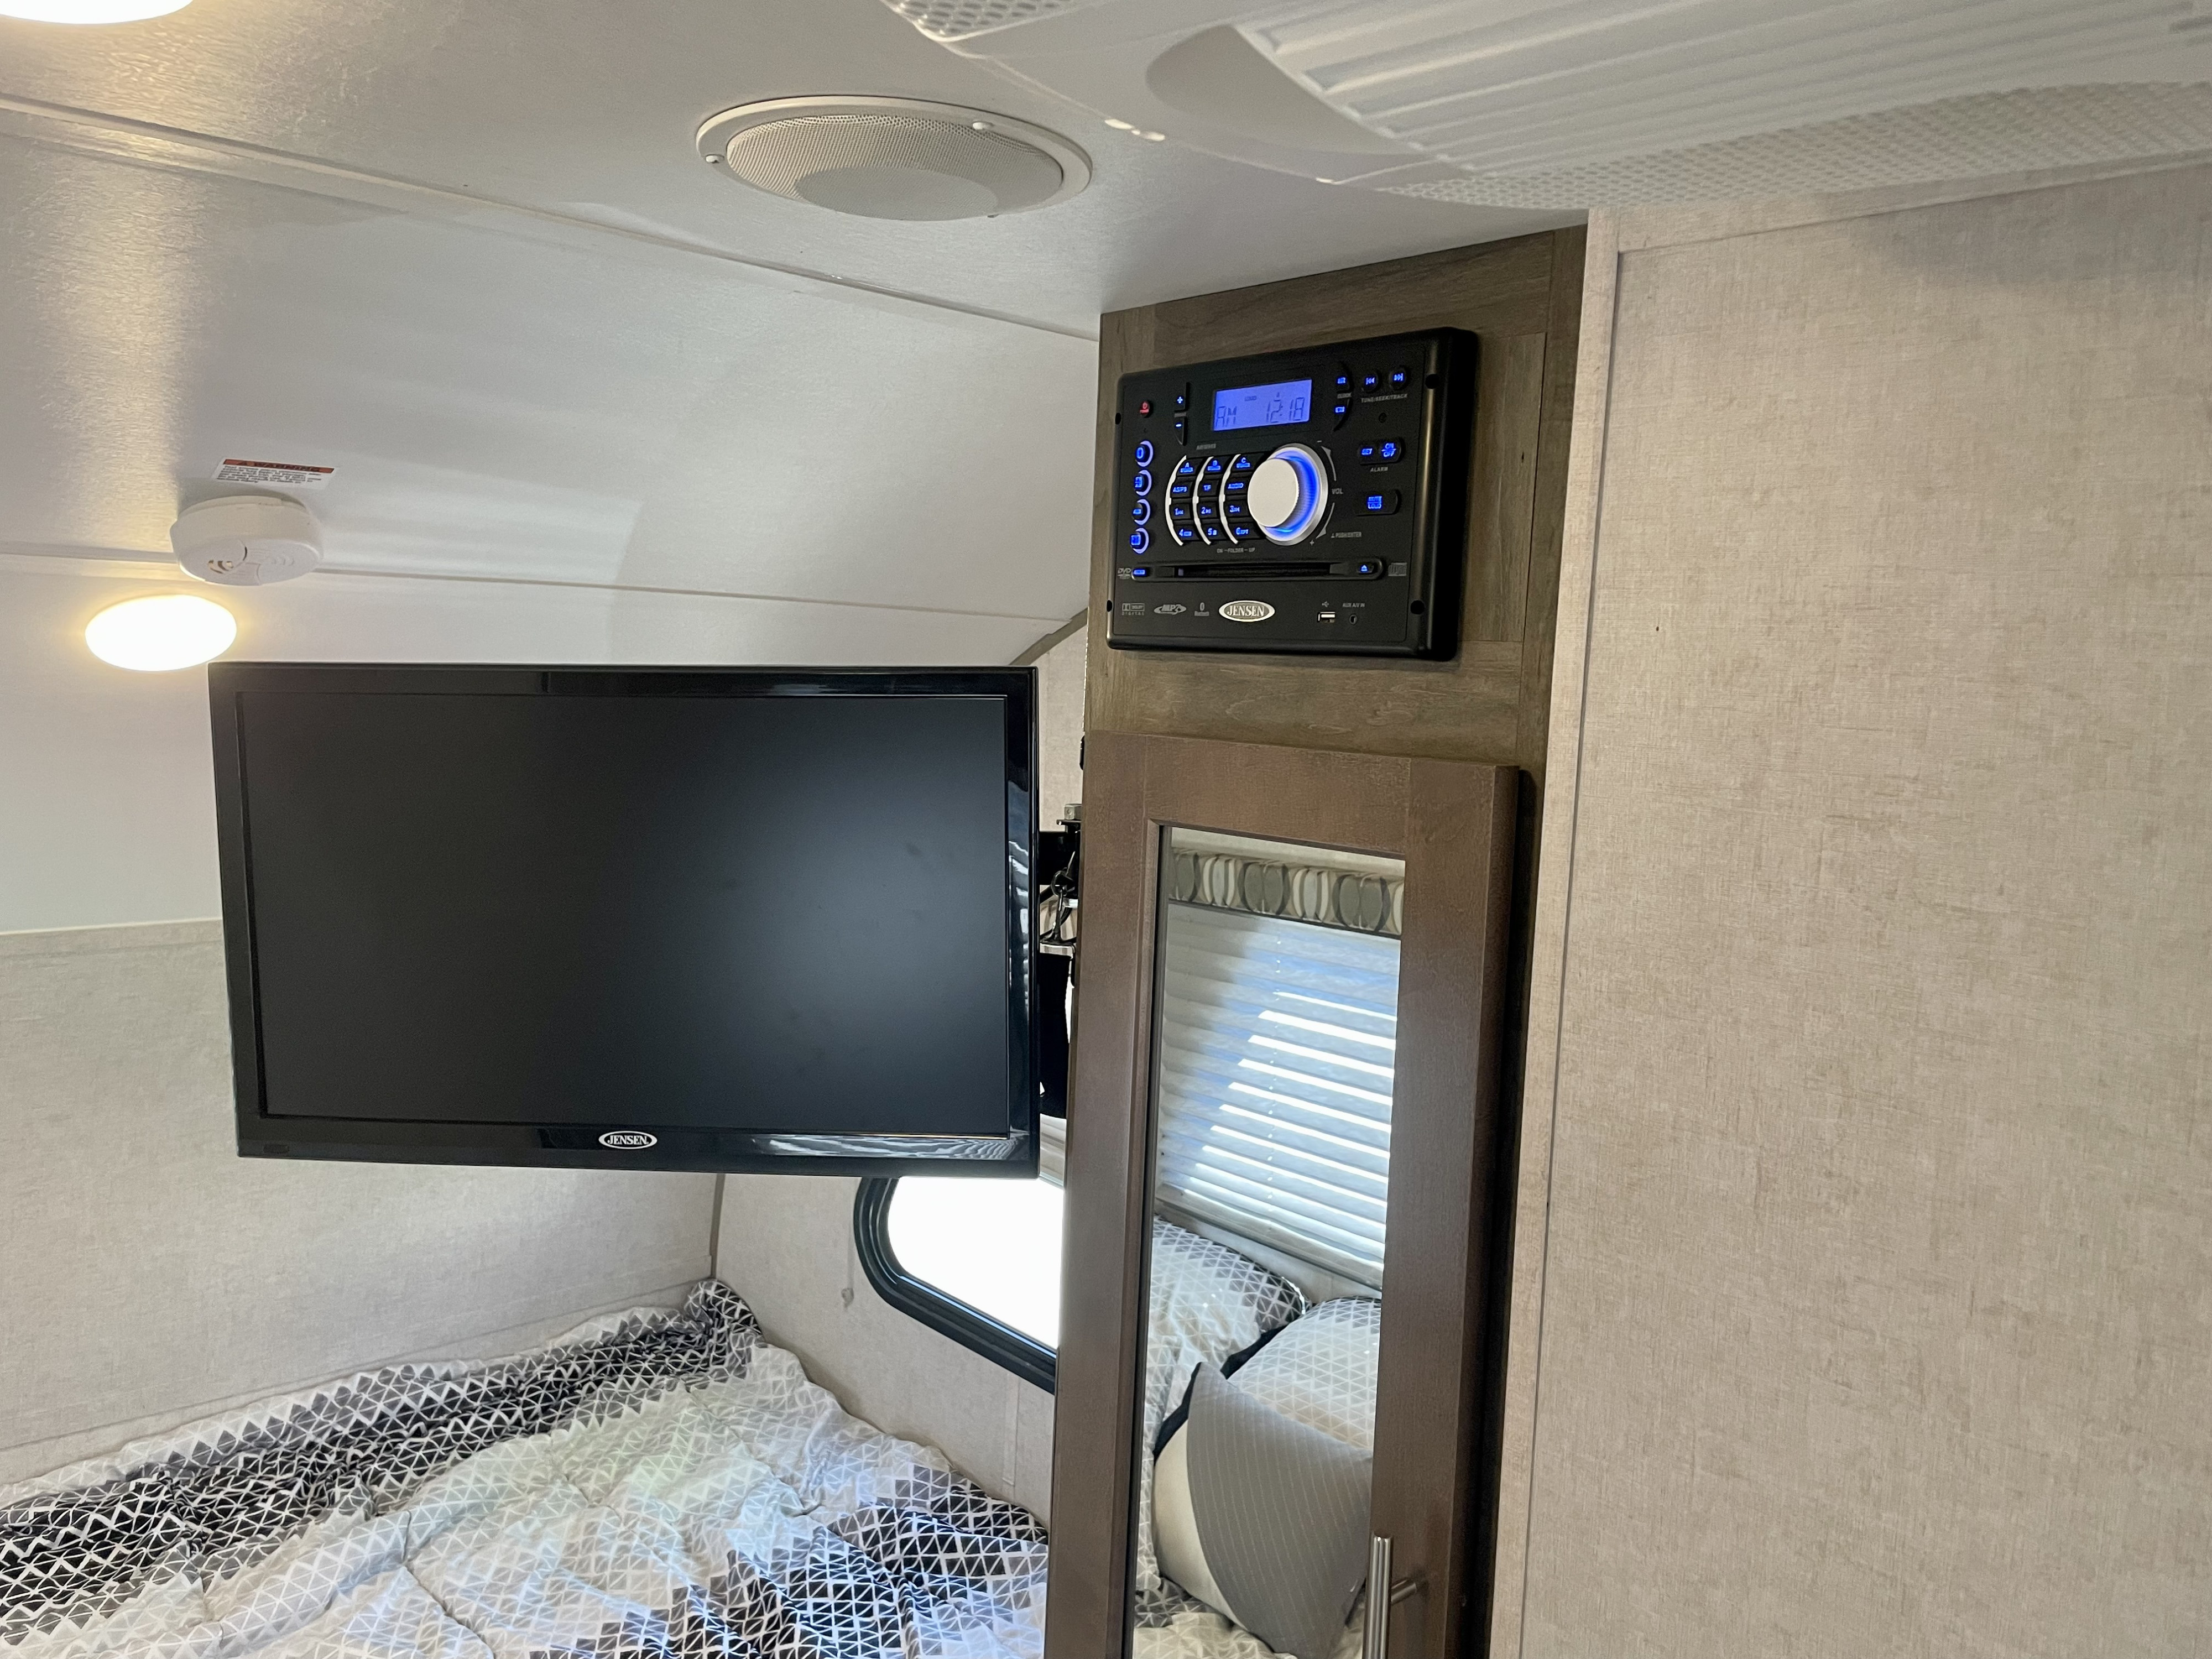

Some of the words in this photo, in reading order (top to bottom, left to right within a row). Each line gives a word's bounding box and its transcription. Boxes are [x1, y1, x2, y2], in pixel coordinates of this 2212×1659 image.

[1266, 397, 1305, 424] 12:18
[1227, 605, 1265, 617] JENSEN
[607, 1135, 648, 1145] JENSEN
